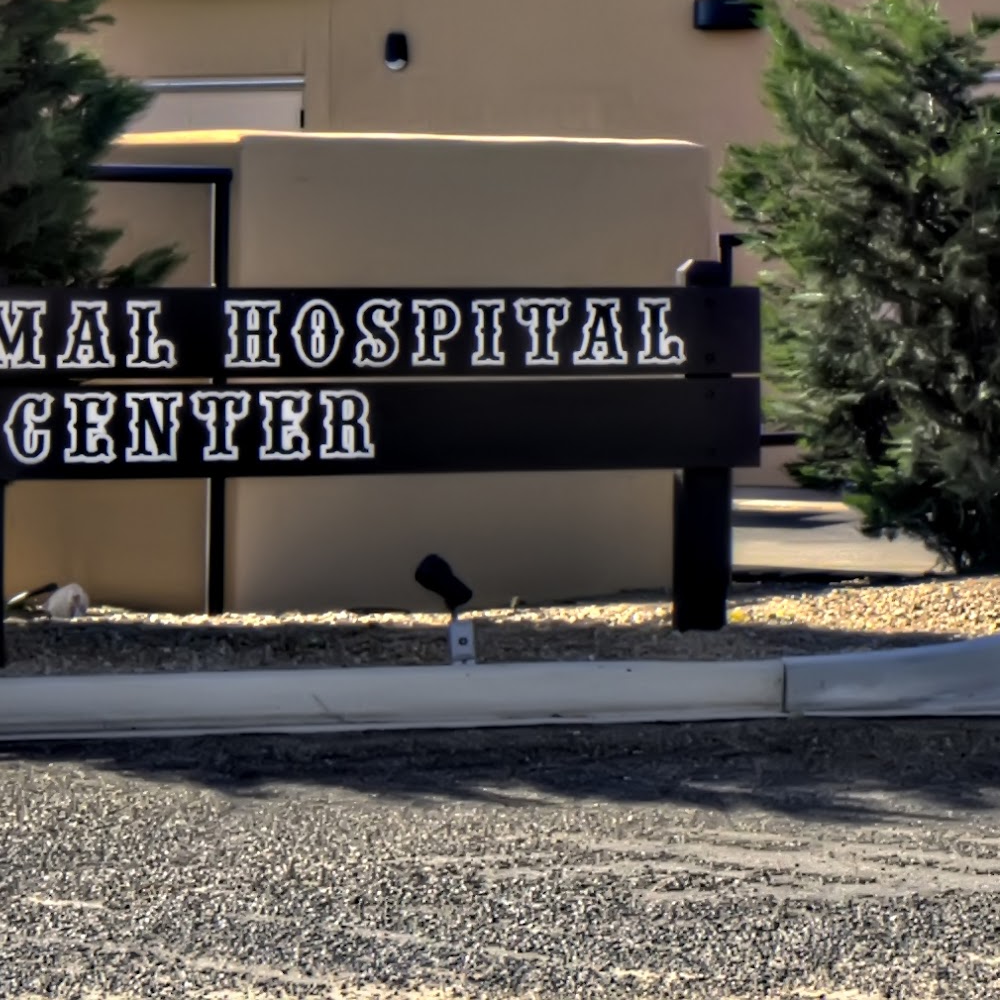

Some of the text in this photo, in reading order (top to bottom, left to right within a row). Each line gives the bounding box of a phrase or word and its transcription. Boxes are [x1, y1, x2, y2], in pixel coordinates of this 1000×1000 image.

[0, 298, 687, 369] MAL HOSPITAL
[3, 390, 375, 464] CENTER
